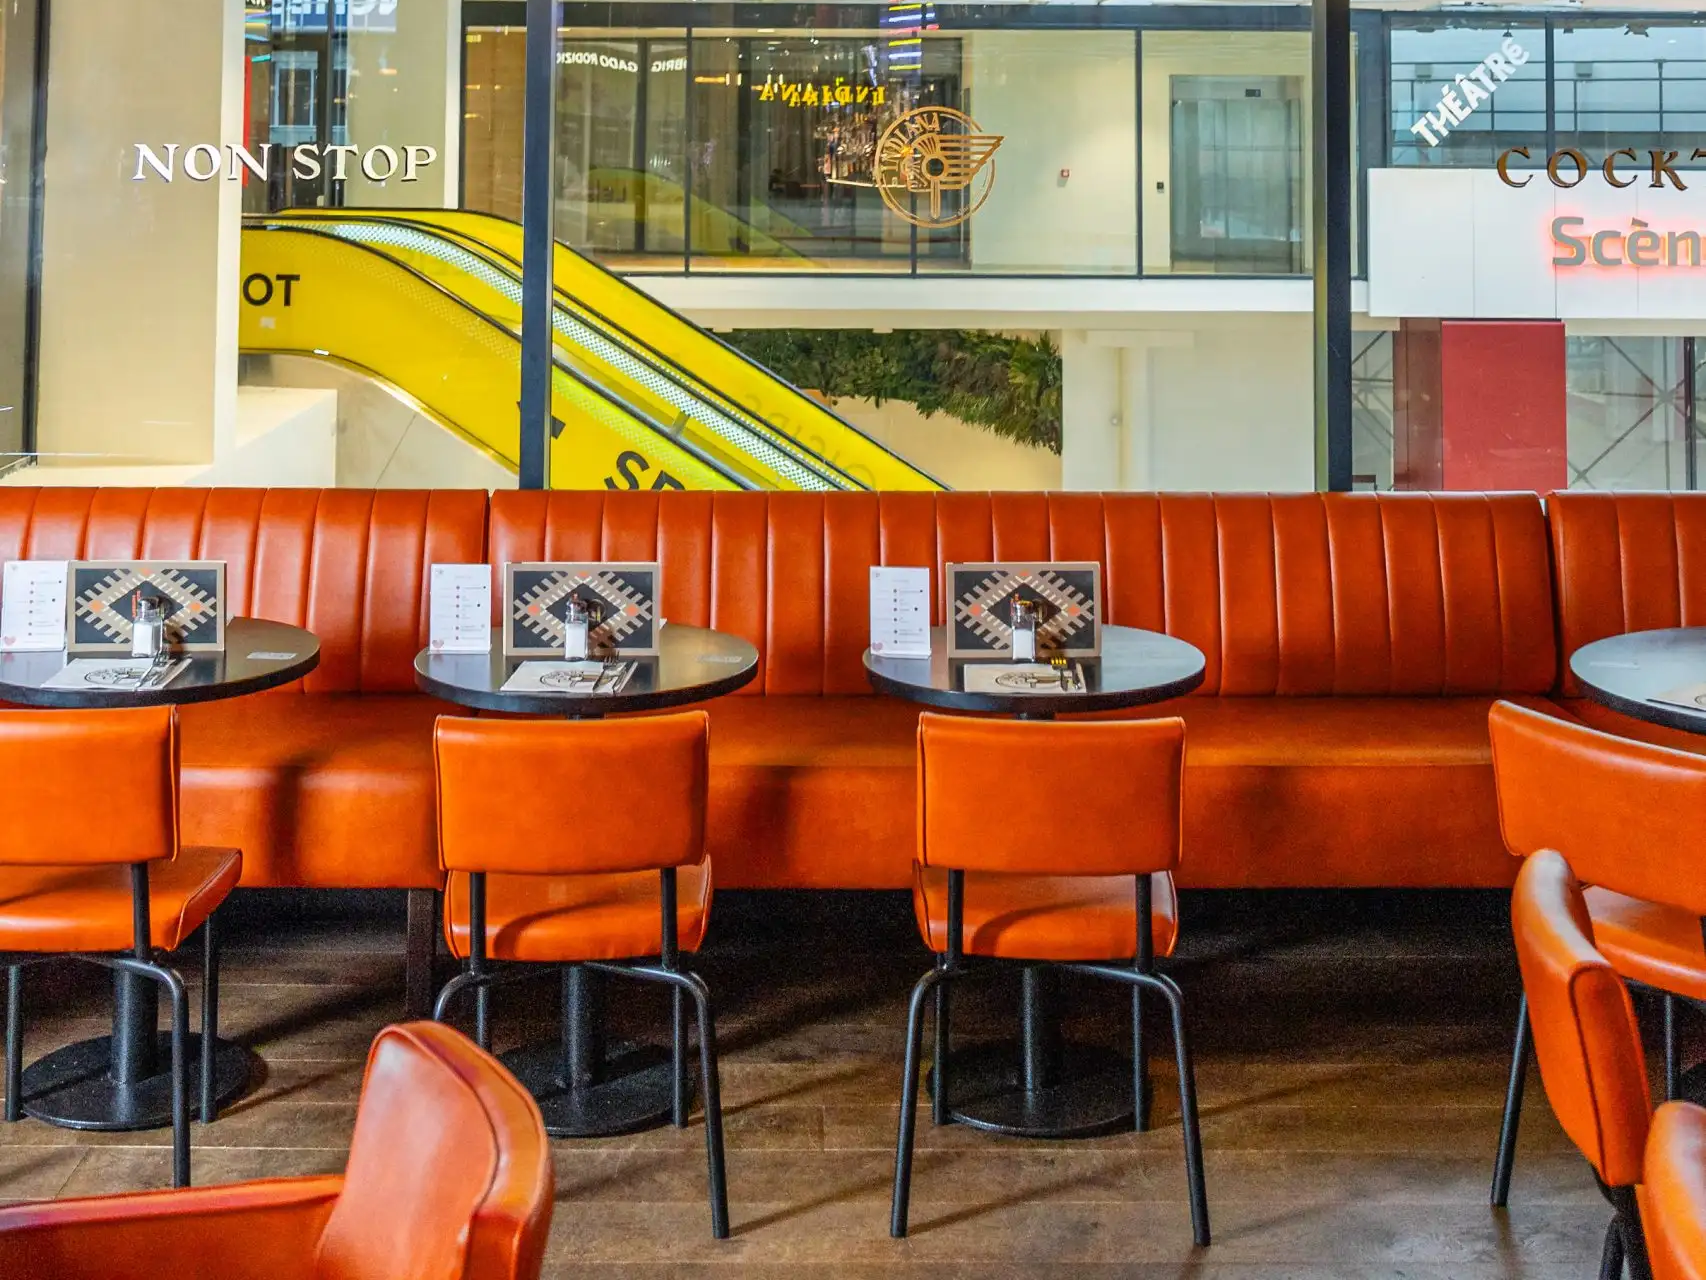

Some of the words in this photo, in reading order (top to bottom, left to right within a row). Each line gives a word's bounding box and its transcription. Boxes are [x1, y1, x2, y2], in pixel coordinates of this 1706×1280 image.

[132, 143, 273, 183] NON
[292, 143, 438, 183] STOP
[880, 111, 941, 172] INDIANA
